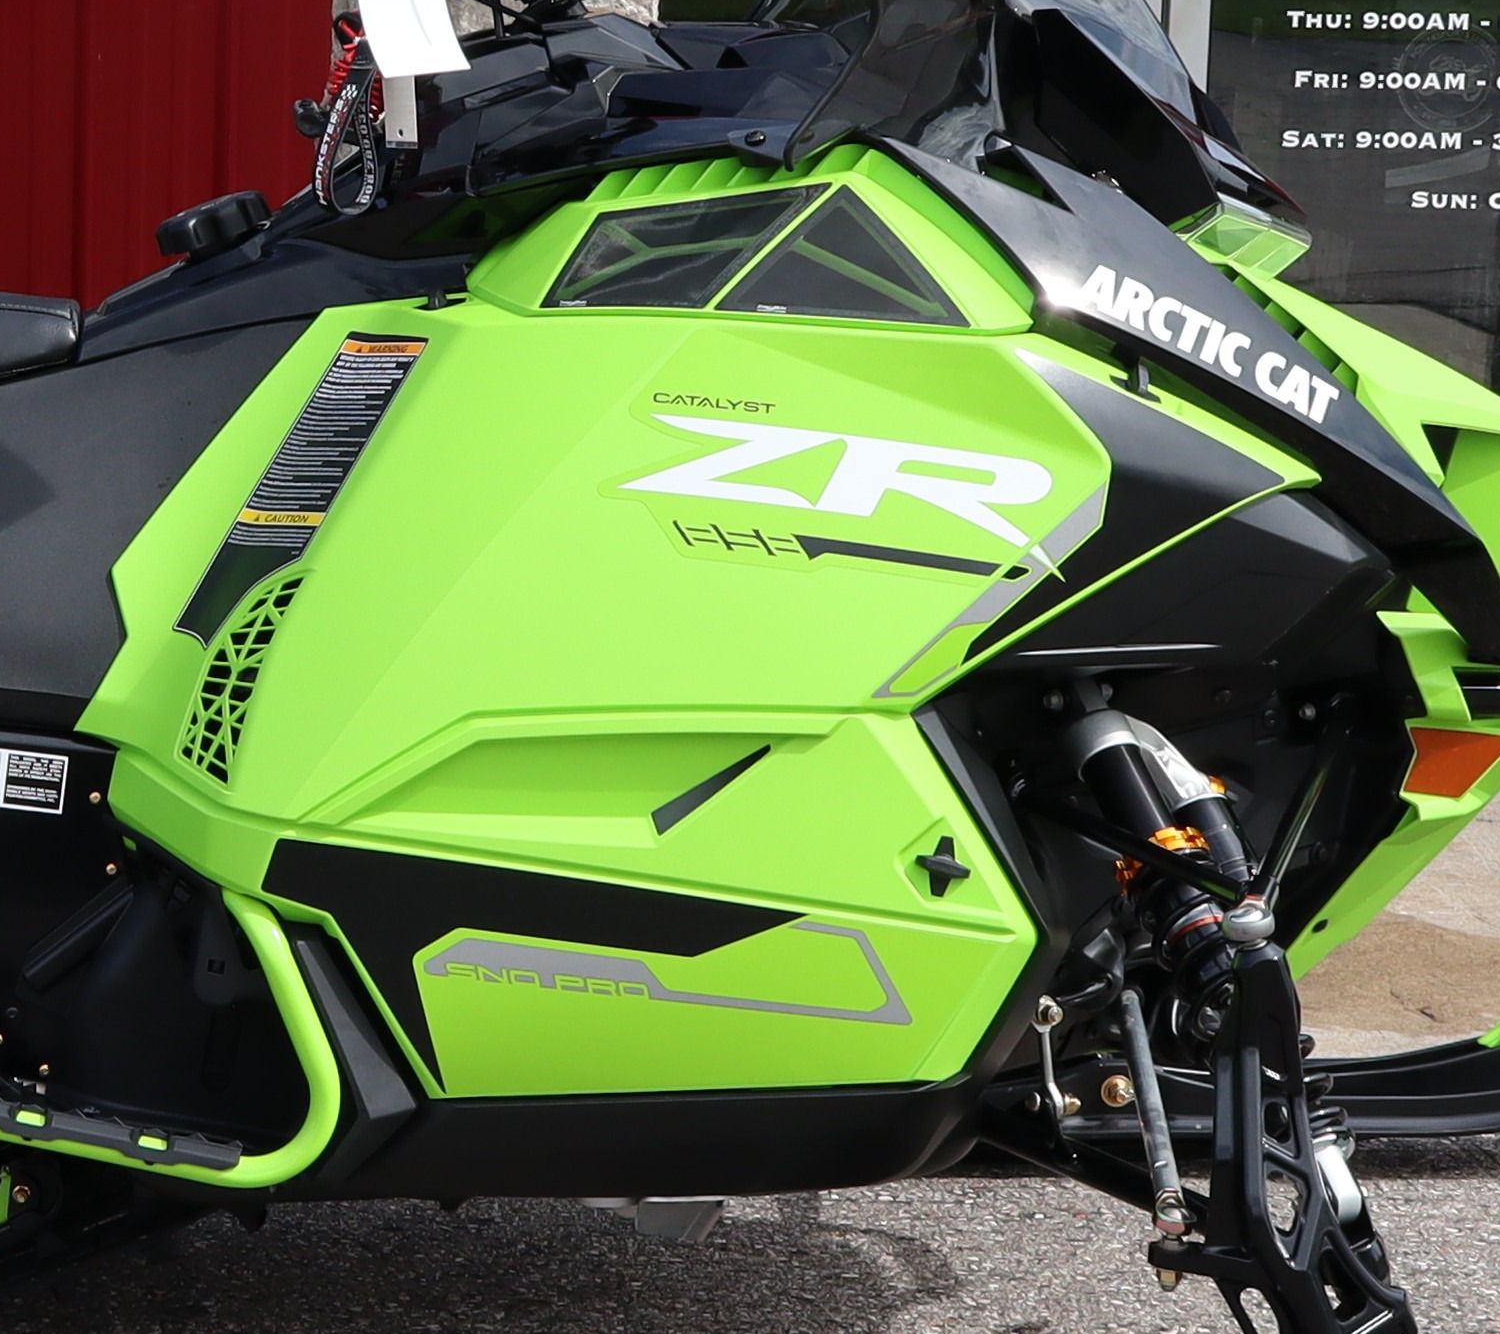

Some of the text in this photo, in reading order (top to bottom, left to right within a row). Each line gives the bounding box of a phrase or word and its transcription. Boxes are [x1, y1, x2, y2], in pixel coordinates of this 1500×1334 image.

[1363, 12, 1470, 31] 9:00AM
[1359, 71, 1466, 91] 9:00AM
[1355, 131, 1462, 150] 9:00AM
[1081, 265, 1340, 425] ARCTIC CAT
[652, 392, 776, 415] CATALYST
[619, 414, 1066, 583] ZR
[264, 514, 309, 523] CAUTION
[443, 961, 652, 999] SNO PRO
